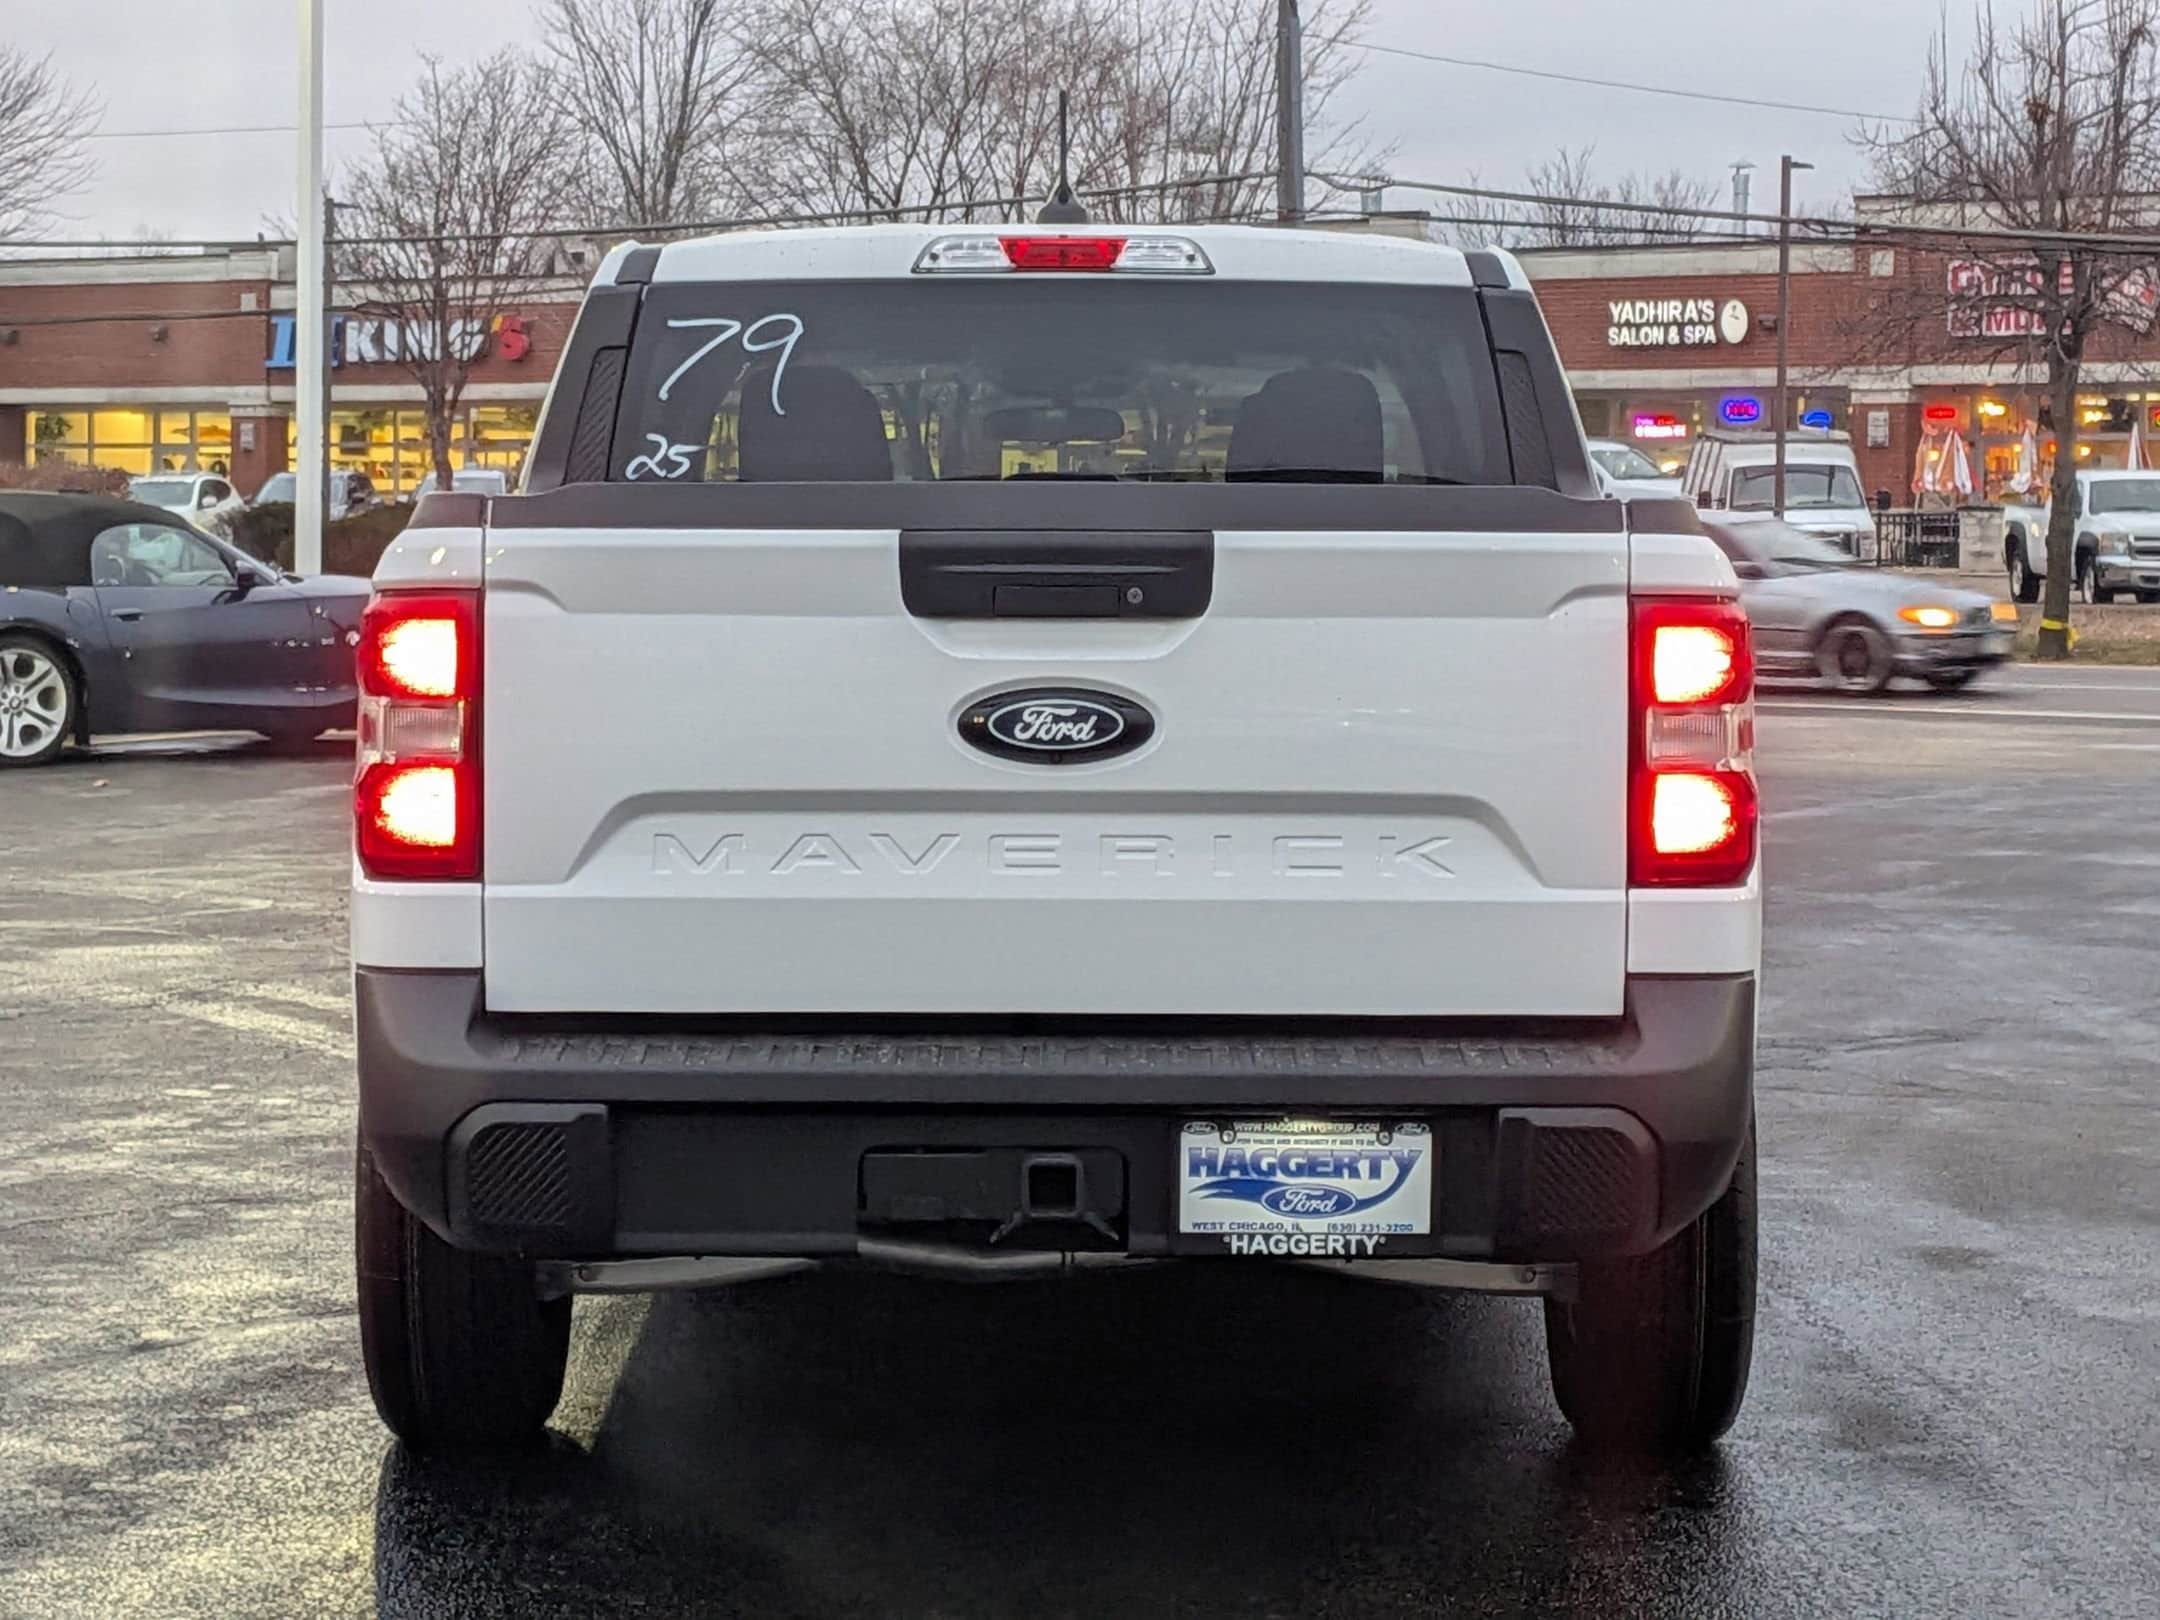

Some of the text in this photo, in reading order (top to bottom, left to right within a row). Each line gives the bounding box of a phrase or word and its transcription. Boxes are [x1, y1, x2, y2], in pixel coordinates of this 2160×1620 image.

[1608, 299, 1715, 324] YADHIRA'S
[1608, 325, 1717, 346] SALON & SPA
[658, 313, 804, 415] 79
[625, 432, 707, 481] 25
[1013, 706, 1098, 741] Ford
[652, 833, 1457, 879] MAVERICK
[1188, 1146, 1423, 1180] HAGGERTY
[1279, 1188, 1337, 1213] Ford
[1192, 1222, 1225, 1231] WEST
